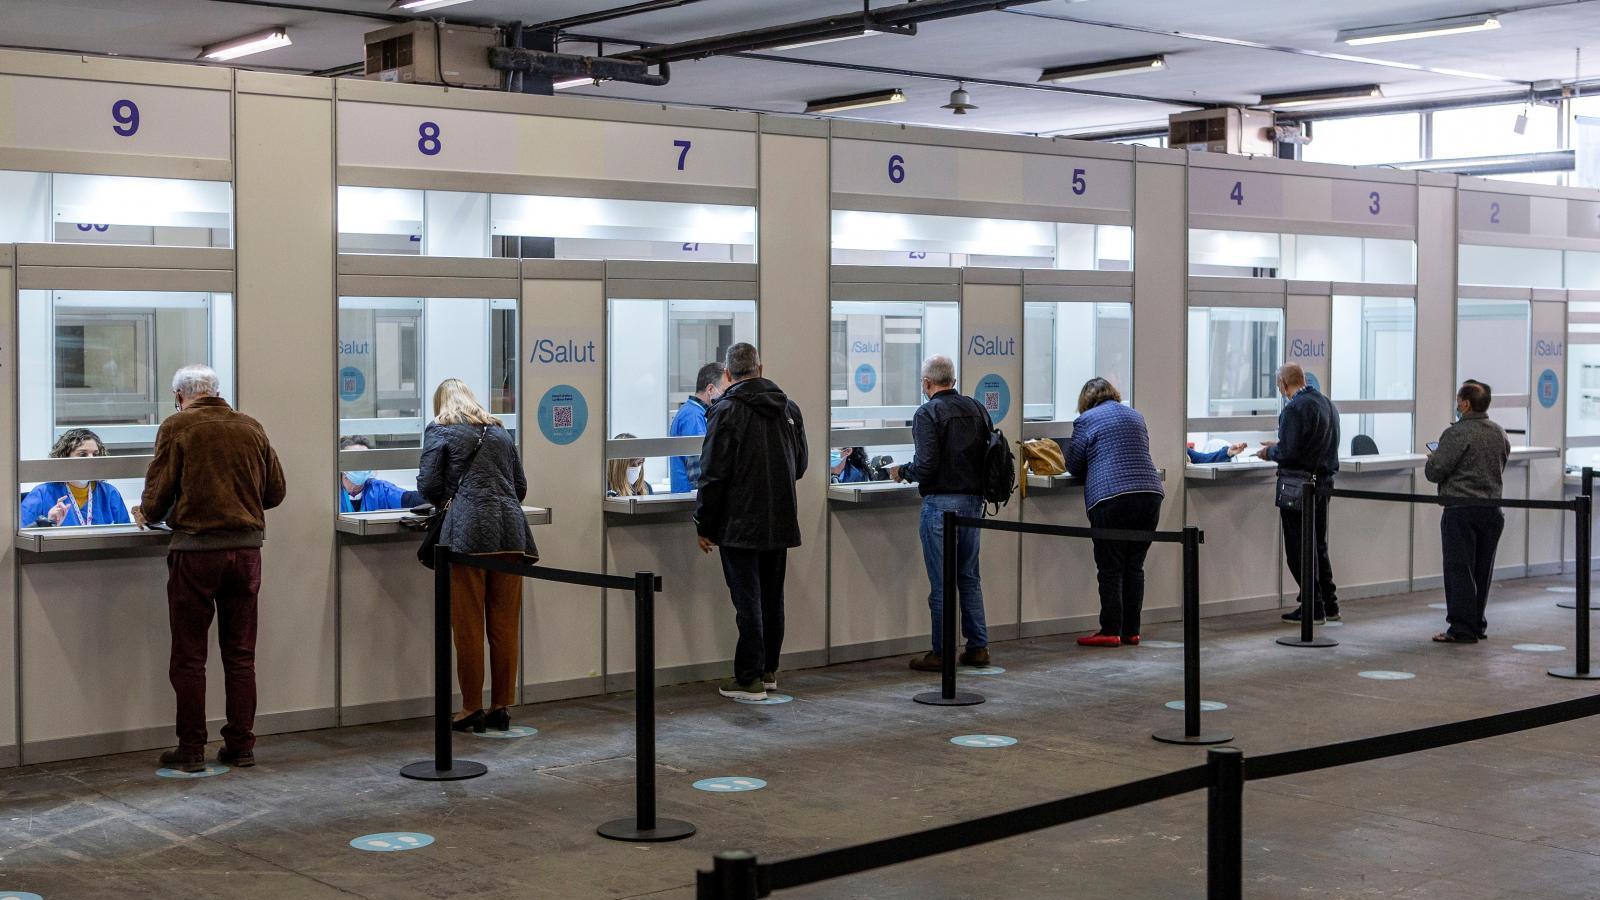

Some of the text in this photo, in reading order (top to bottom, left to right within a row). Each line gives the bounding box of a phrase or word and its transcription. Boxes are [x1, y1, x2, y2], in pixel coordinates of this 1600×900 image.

[112, 99, 139, 137] 9
[417, 121, 442, 156] 8
[673, 140, 692, 171] 7
[888, 155, 905, 184] 6
[1072, 169, 1086, 195] 5
[1230, 182, 1243, 205] 4
[1369, 191, 1381, 216] 3
[1490, 202, 1500, 224] 2
[530, 339, 596, 363] /Salut
[968, 335, 1015, 356] /Salut
[1290, 339, 1325, 357] /Salut
